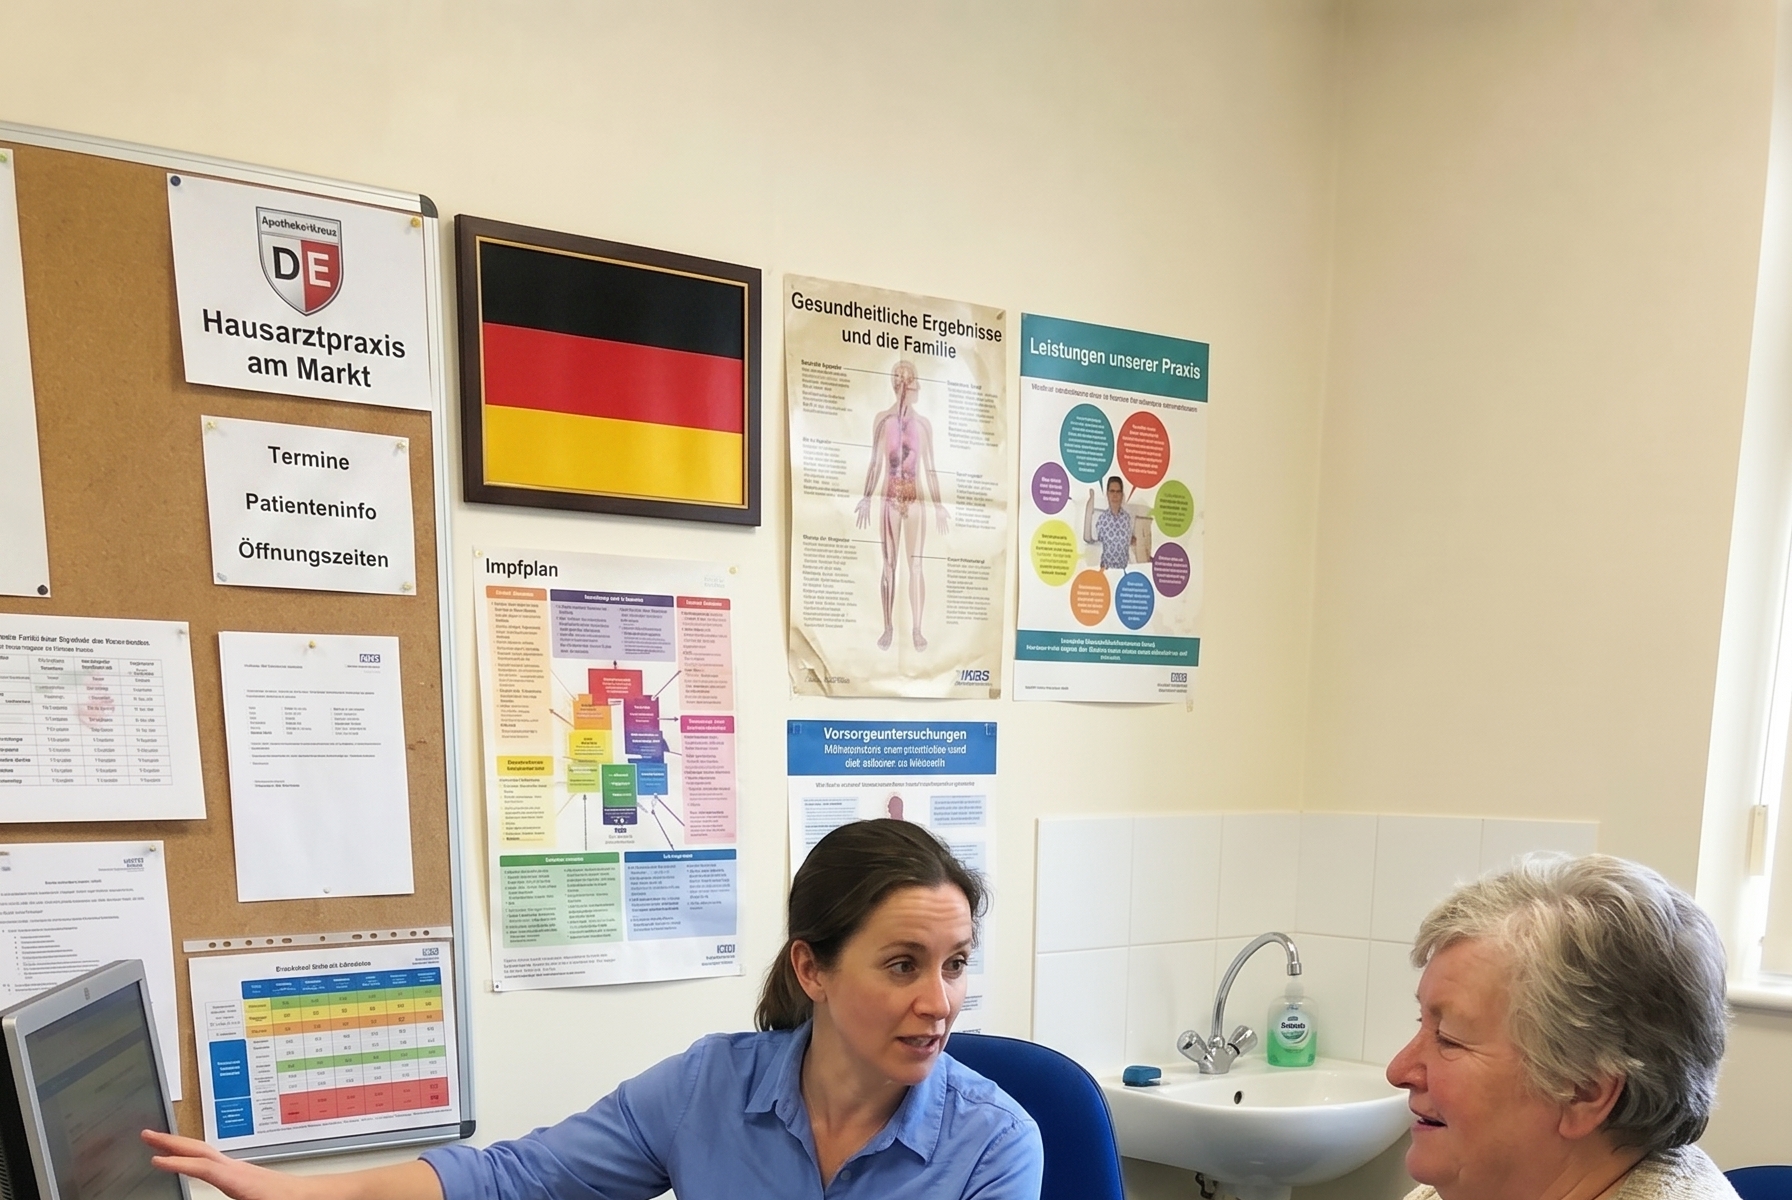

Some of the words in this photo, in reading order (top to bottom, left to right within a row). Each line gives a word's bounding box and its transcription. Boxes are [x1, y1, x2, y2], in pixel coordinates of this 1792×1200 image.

[791, 292, 918, 329] Gesundheitliche
[923, 314, 1002, 342] Ergebnisse
[202, 309, 406, 358] Hausarztpraxis
[842, 329, 871, 346] und
[876, 331, 899, 350] die
[904, 335, 957, 359] Familie
[247, 356, 289, 377] am
[297, 357, 372, 388] Markt
[1030, 337, 1106, 367] Leistungen
[1110, 352, 1159, 373] unserer
[1162, 358, 1201, 380] Praxis
[268, 445, 350, 471] Termine
[245, 493, 377, 521] Patienteninfo
[238, 538, 390, 568] Öffnungszeiten
[485, 558, 559, 579] Impfplan
[824, 727, 967, 743] Vorsorgeuntersuchungen
